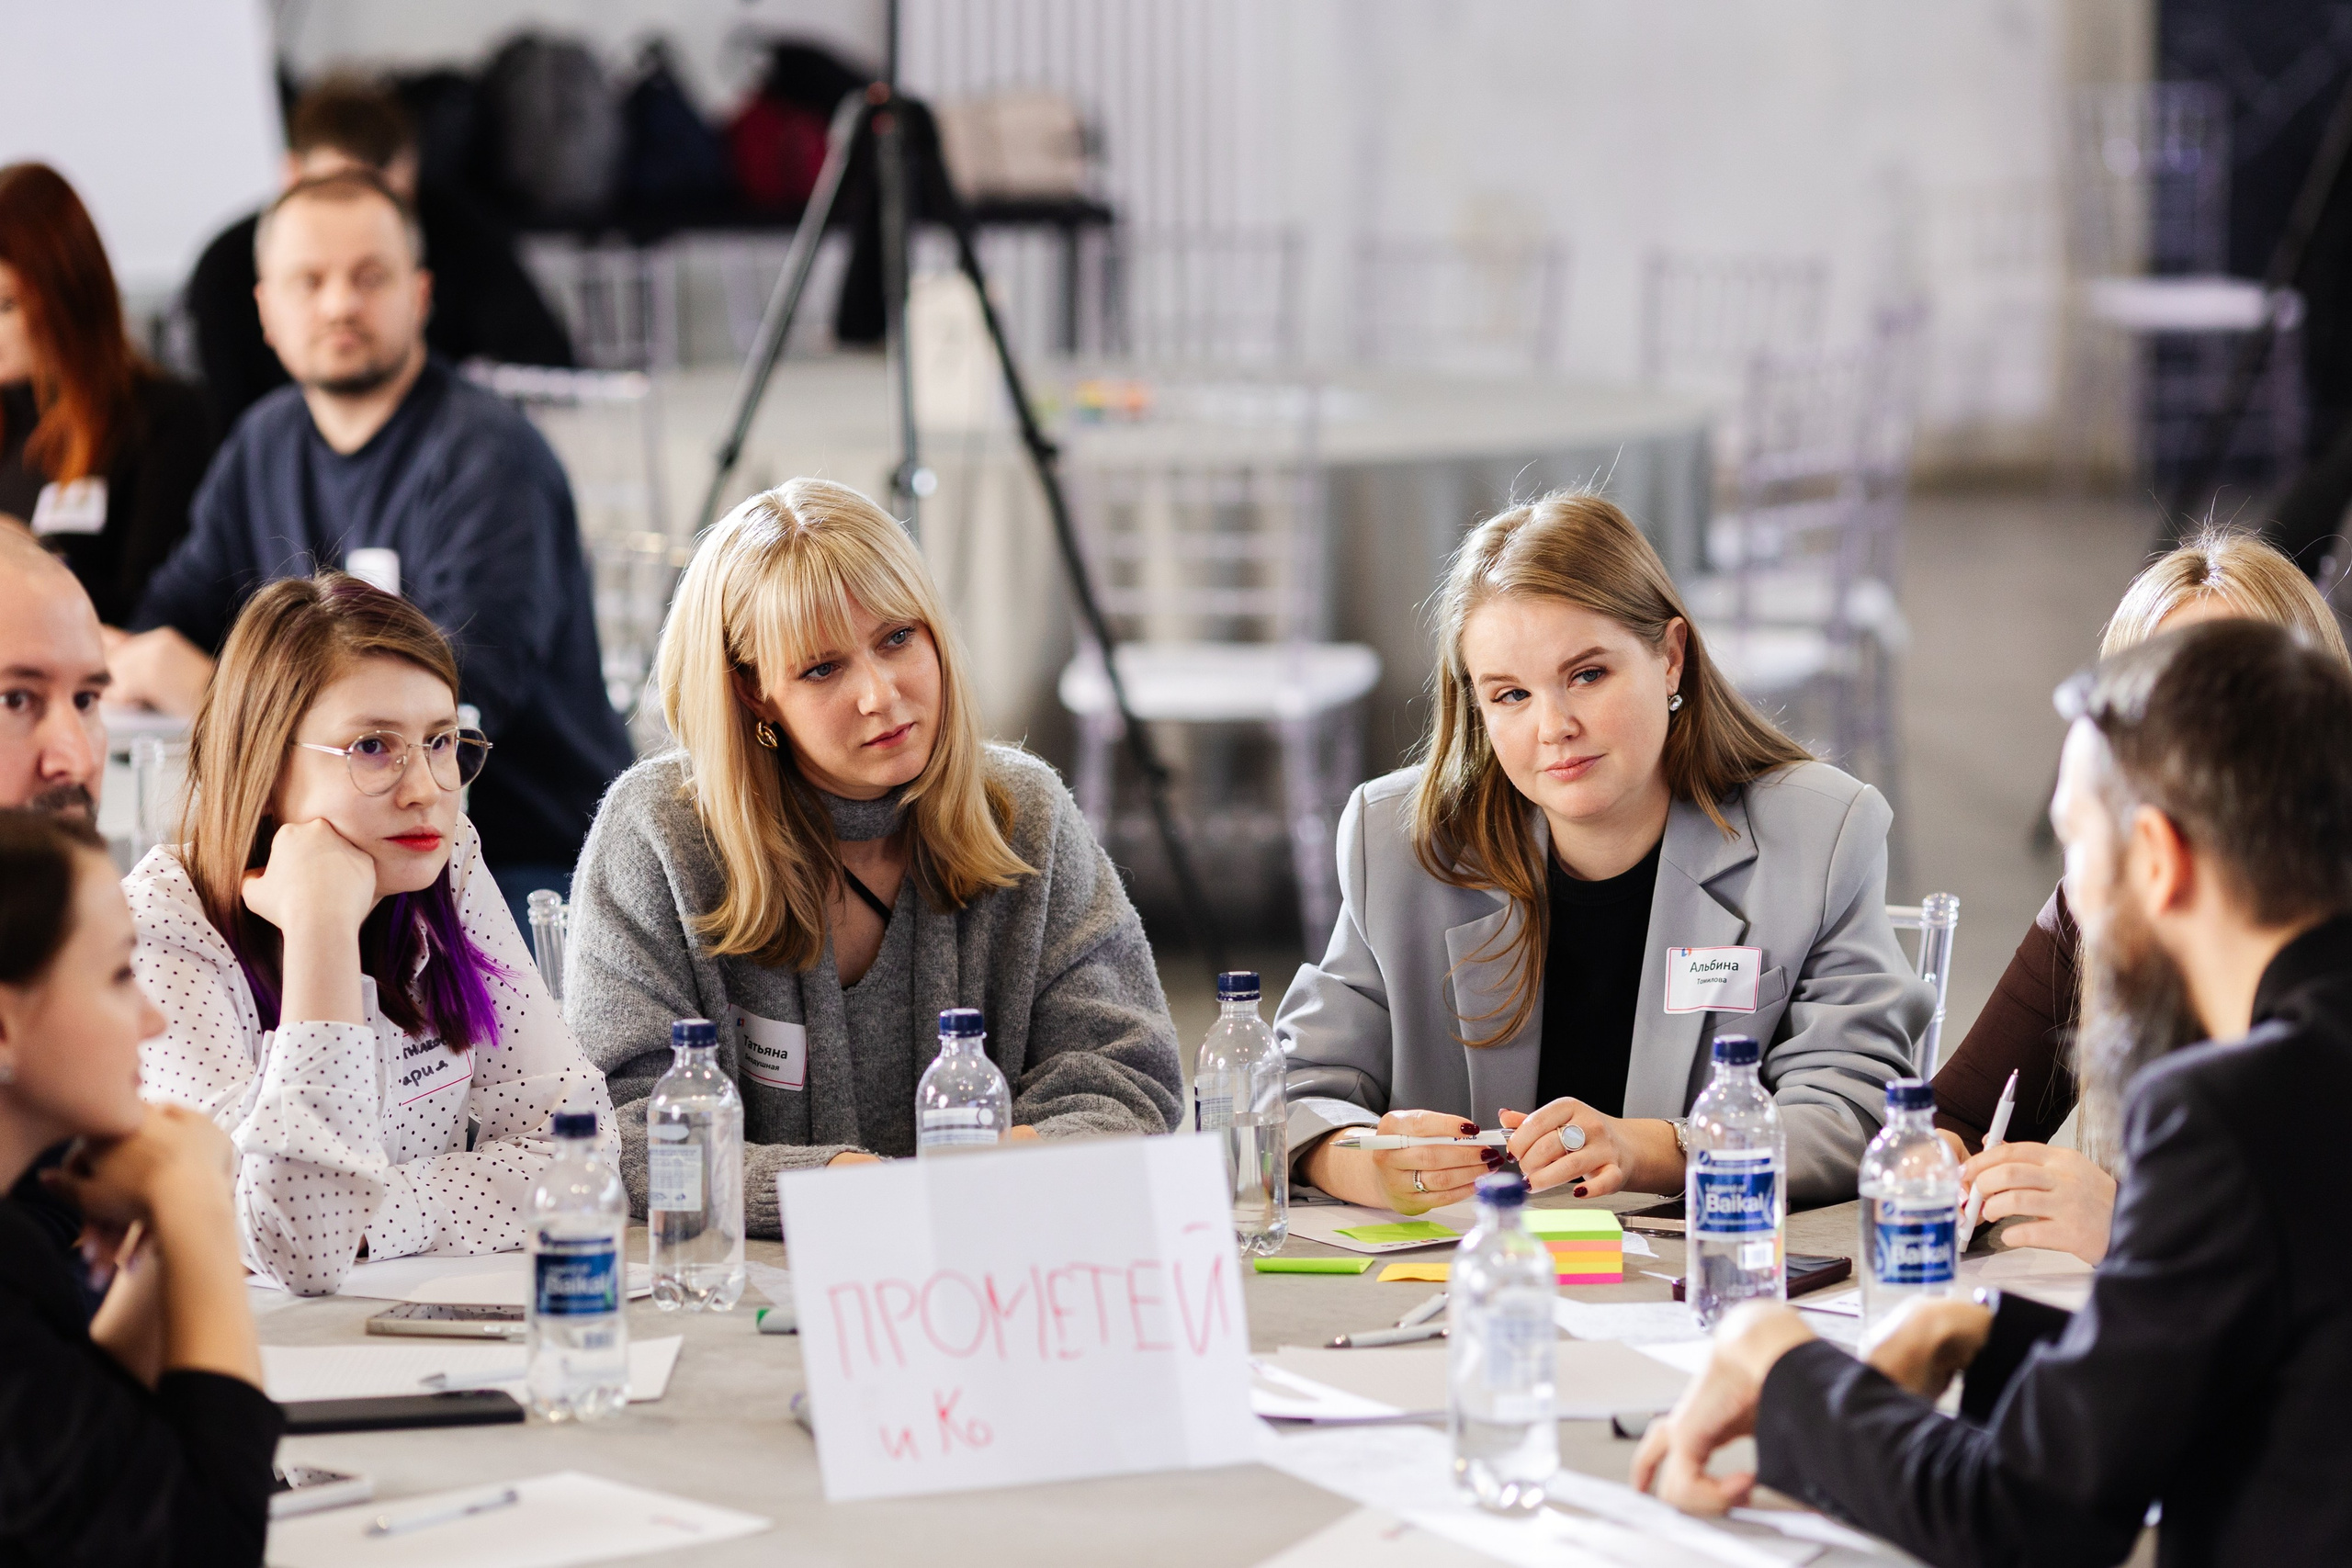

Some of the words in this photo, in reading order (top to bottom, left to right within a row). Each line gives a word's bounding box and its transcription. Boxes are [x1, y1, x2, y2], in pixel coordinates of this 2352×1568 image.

[1690, 959, 1739, 973] Альбина
[1697, 976, 1727, 985] Томилова
[743, 1034, 788, 1059] Татьяна
[402, 1059, 449, 1087] ария
[1705, 1191, 1764, 1213] Baikal
[827, 1223, 1231, 1381] ПРОМЕТЕЙ
[933, 1386, 994, 1454] Ко
